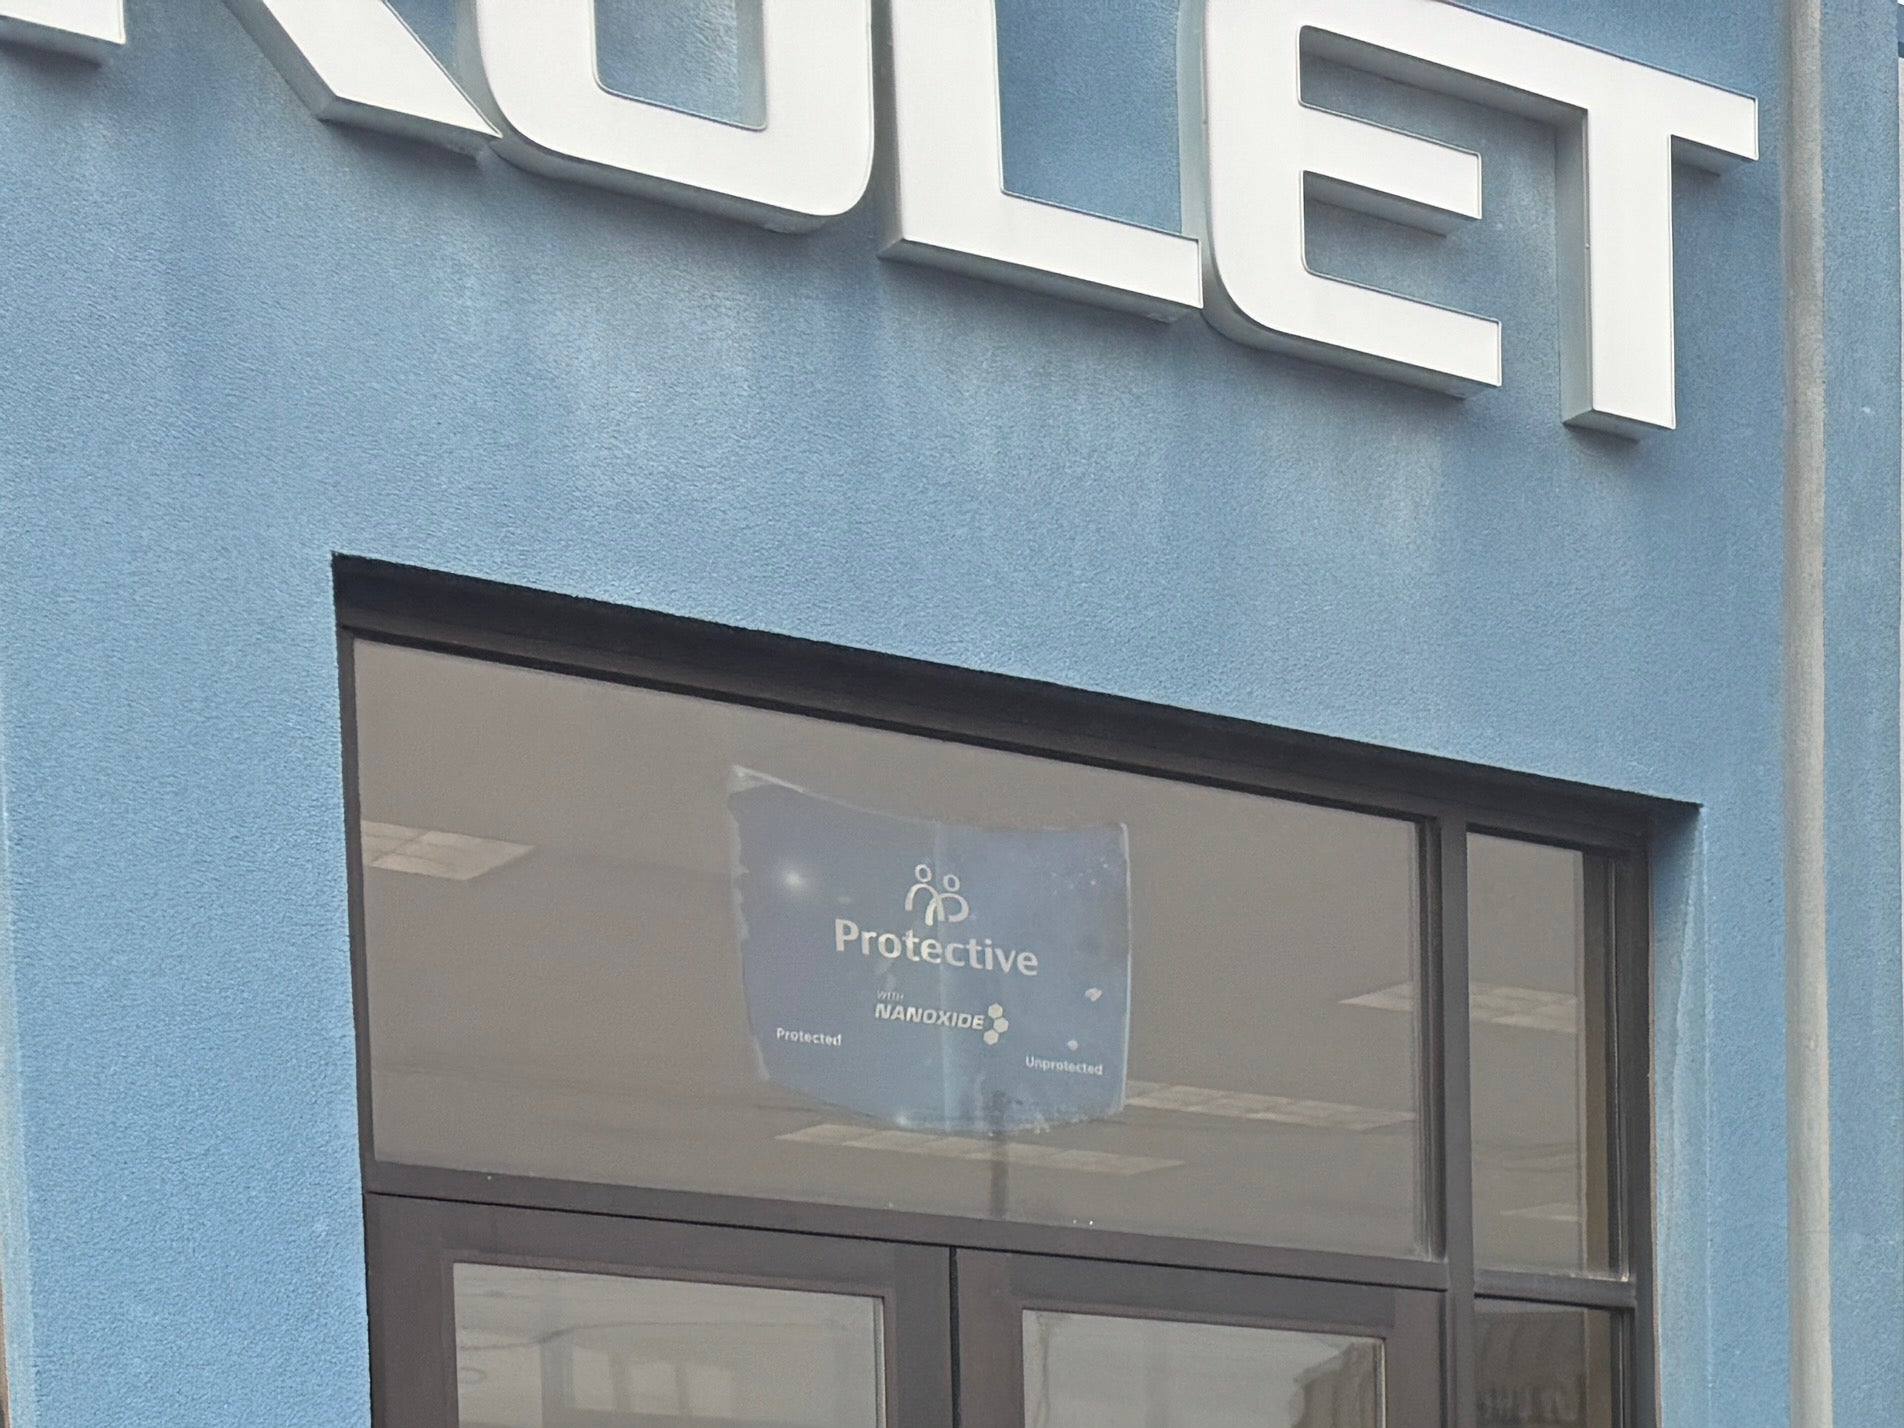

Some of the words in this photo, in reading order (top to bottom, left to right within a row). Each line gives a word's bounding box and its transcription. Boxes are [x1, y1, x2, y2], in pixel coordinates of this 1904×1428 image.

[834, 918, 1038, 976] Protective
[874, 1003, 985, 1030] NANOXIDE
[776, 1027, 842, 1046] Protected
[1025, 1055, 1103, 1076] Unprotected
